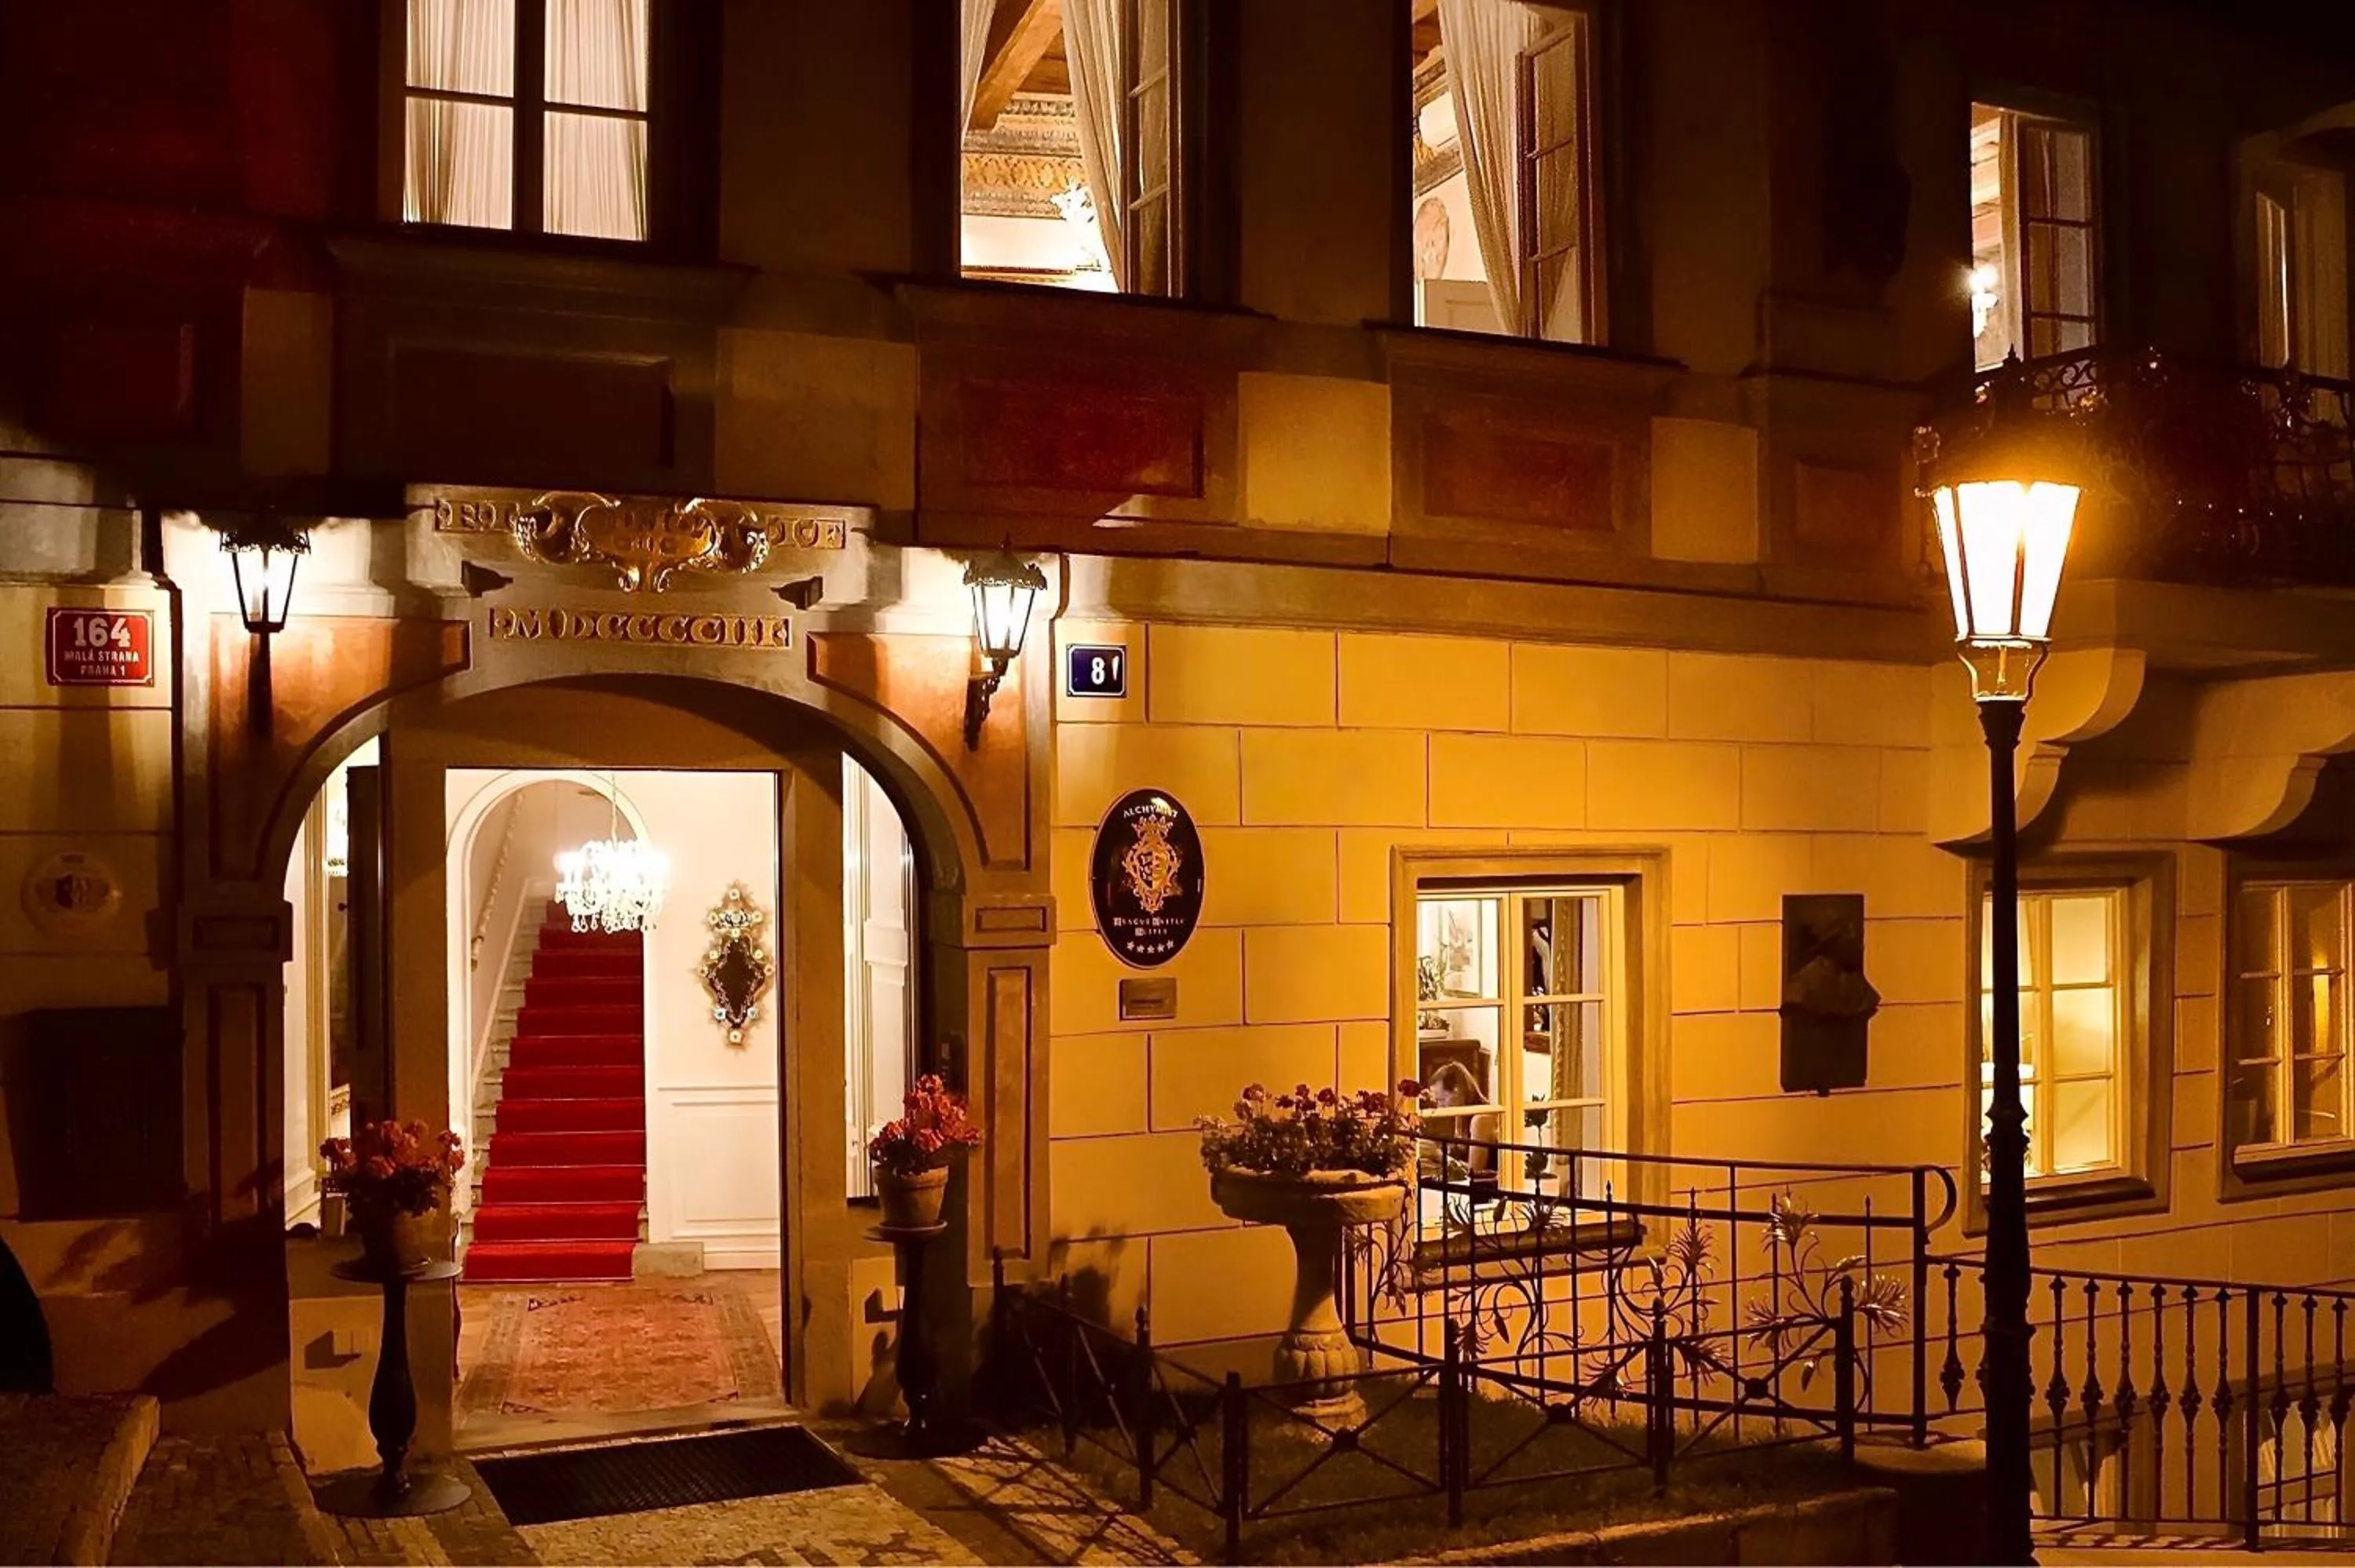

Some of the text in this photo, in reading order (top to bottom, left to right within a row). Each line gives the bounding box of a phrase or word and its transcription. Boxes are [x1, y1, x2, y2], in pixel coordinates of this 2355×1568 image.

[73, 616, 132, 647] 164
[97, 650, 141, 663] STRANA
[80, 665, 126, 676] PRAHA 1
